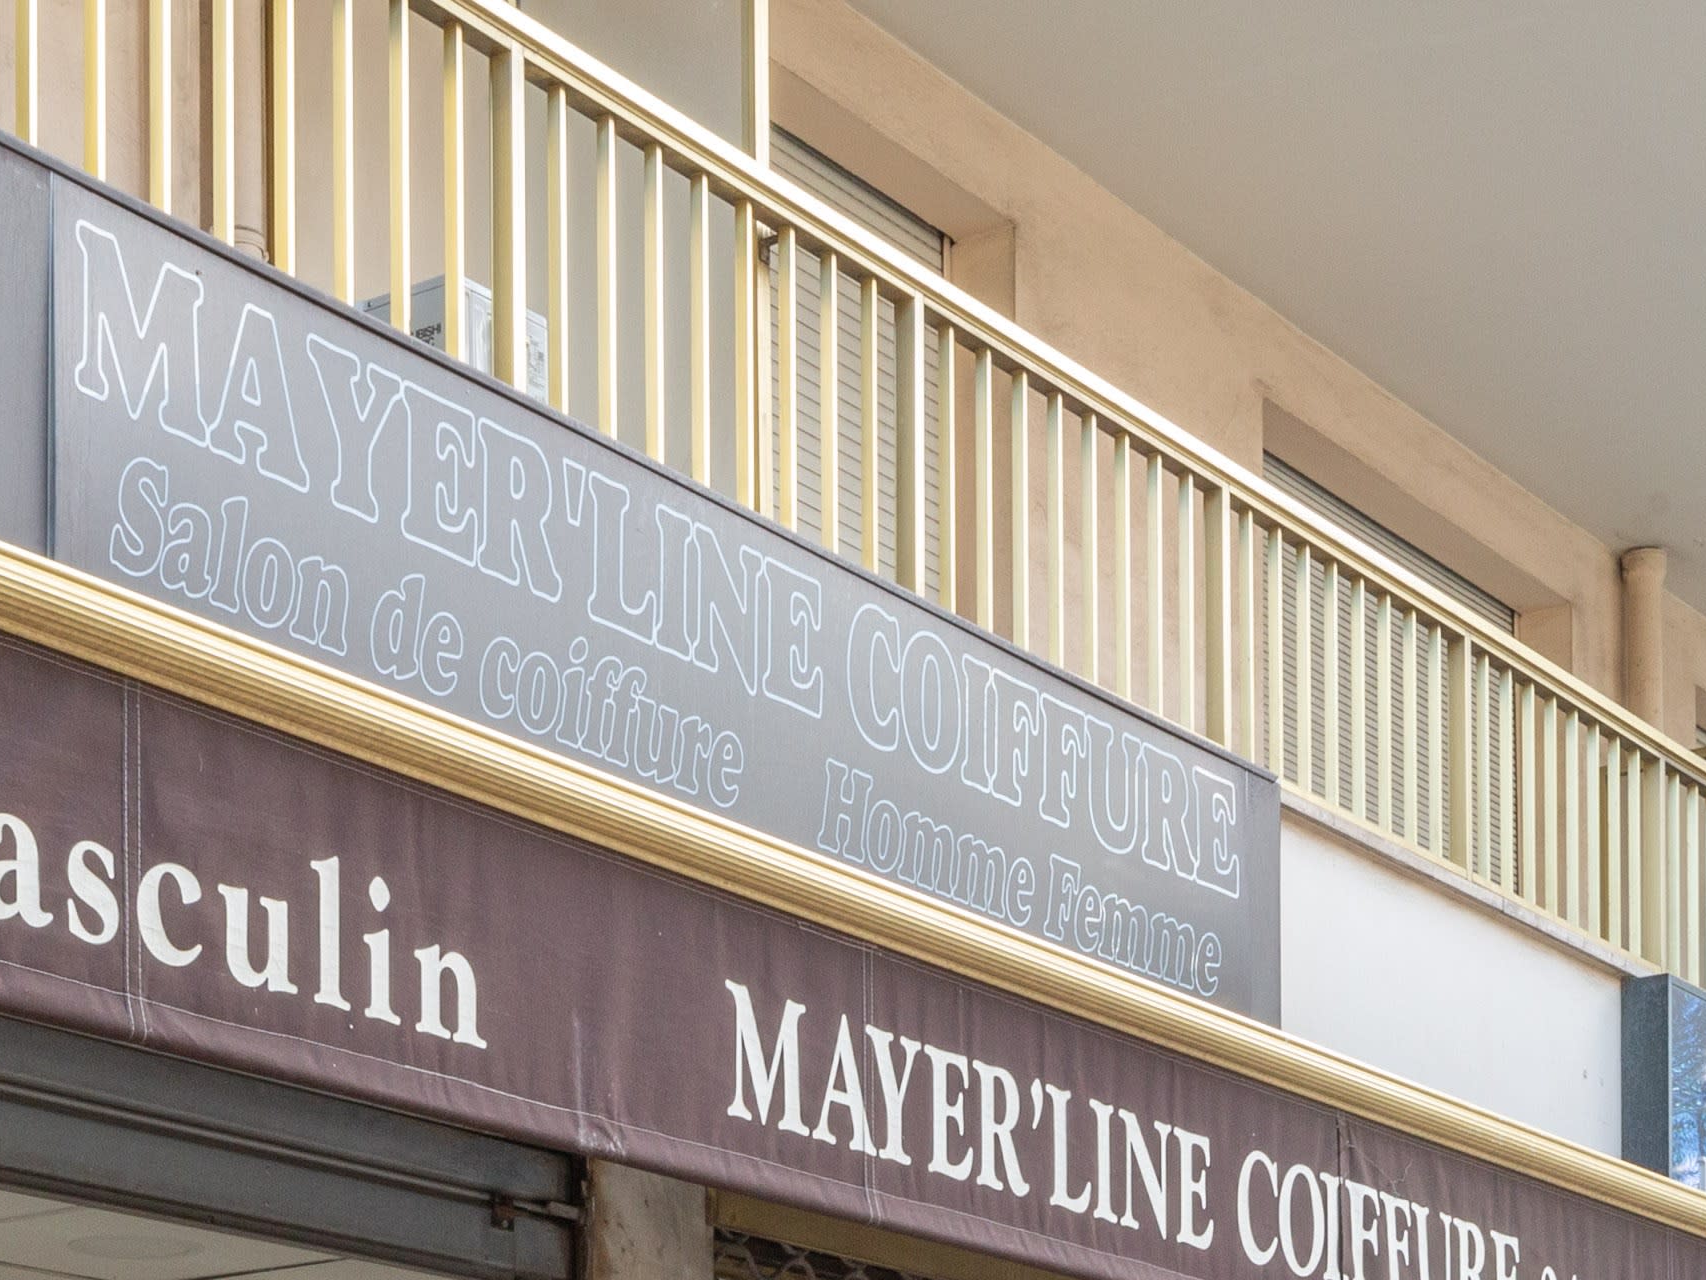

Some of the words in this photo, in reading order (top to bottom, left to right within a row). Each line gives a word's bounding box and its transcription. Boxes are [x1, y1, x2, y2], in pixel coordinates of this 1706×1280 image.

[76, 219, 824, 719] MAYER'LINE
[846, 602, 1240, 899] COIFFURE
[110, 456, 349, 657] Salon
[370, 573, 464, 697] de
[480, 636, 745, 809] coiffure
[816, 757, 1036, 927] Homme
[1043, 853, 1222, 997] Femme
[724, 977, 1215, 1252] MAYER'LINE
